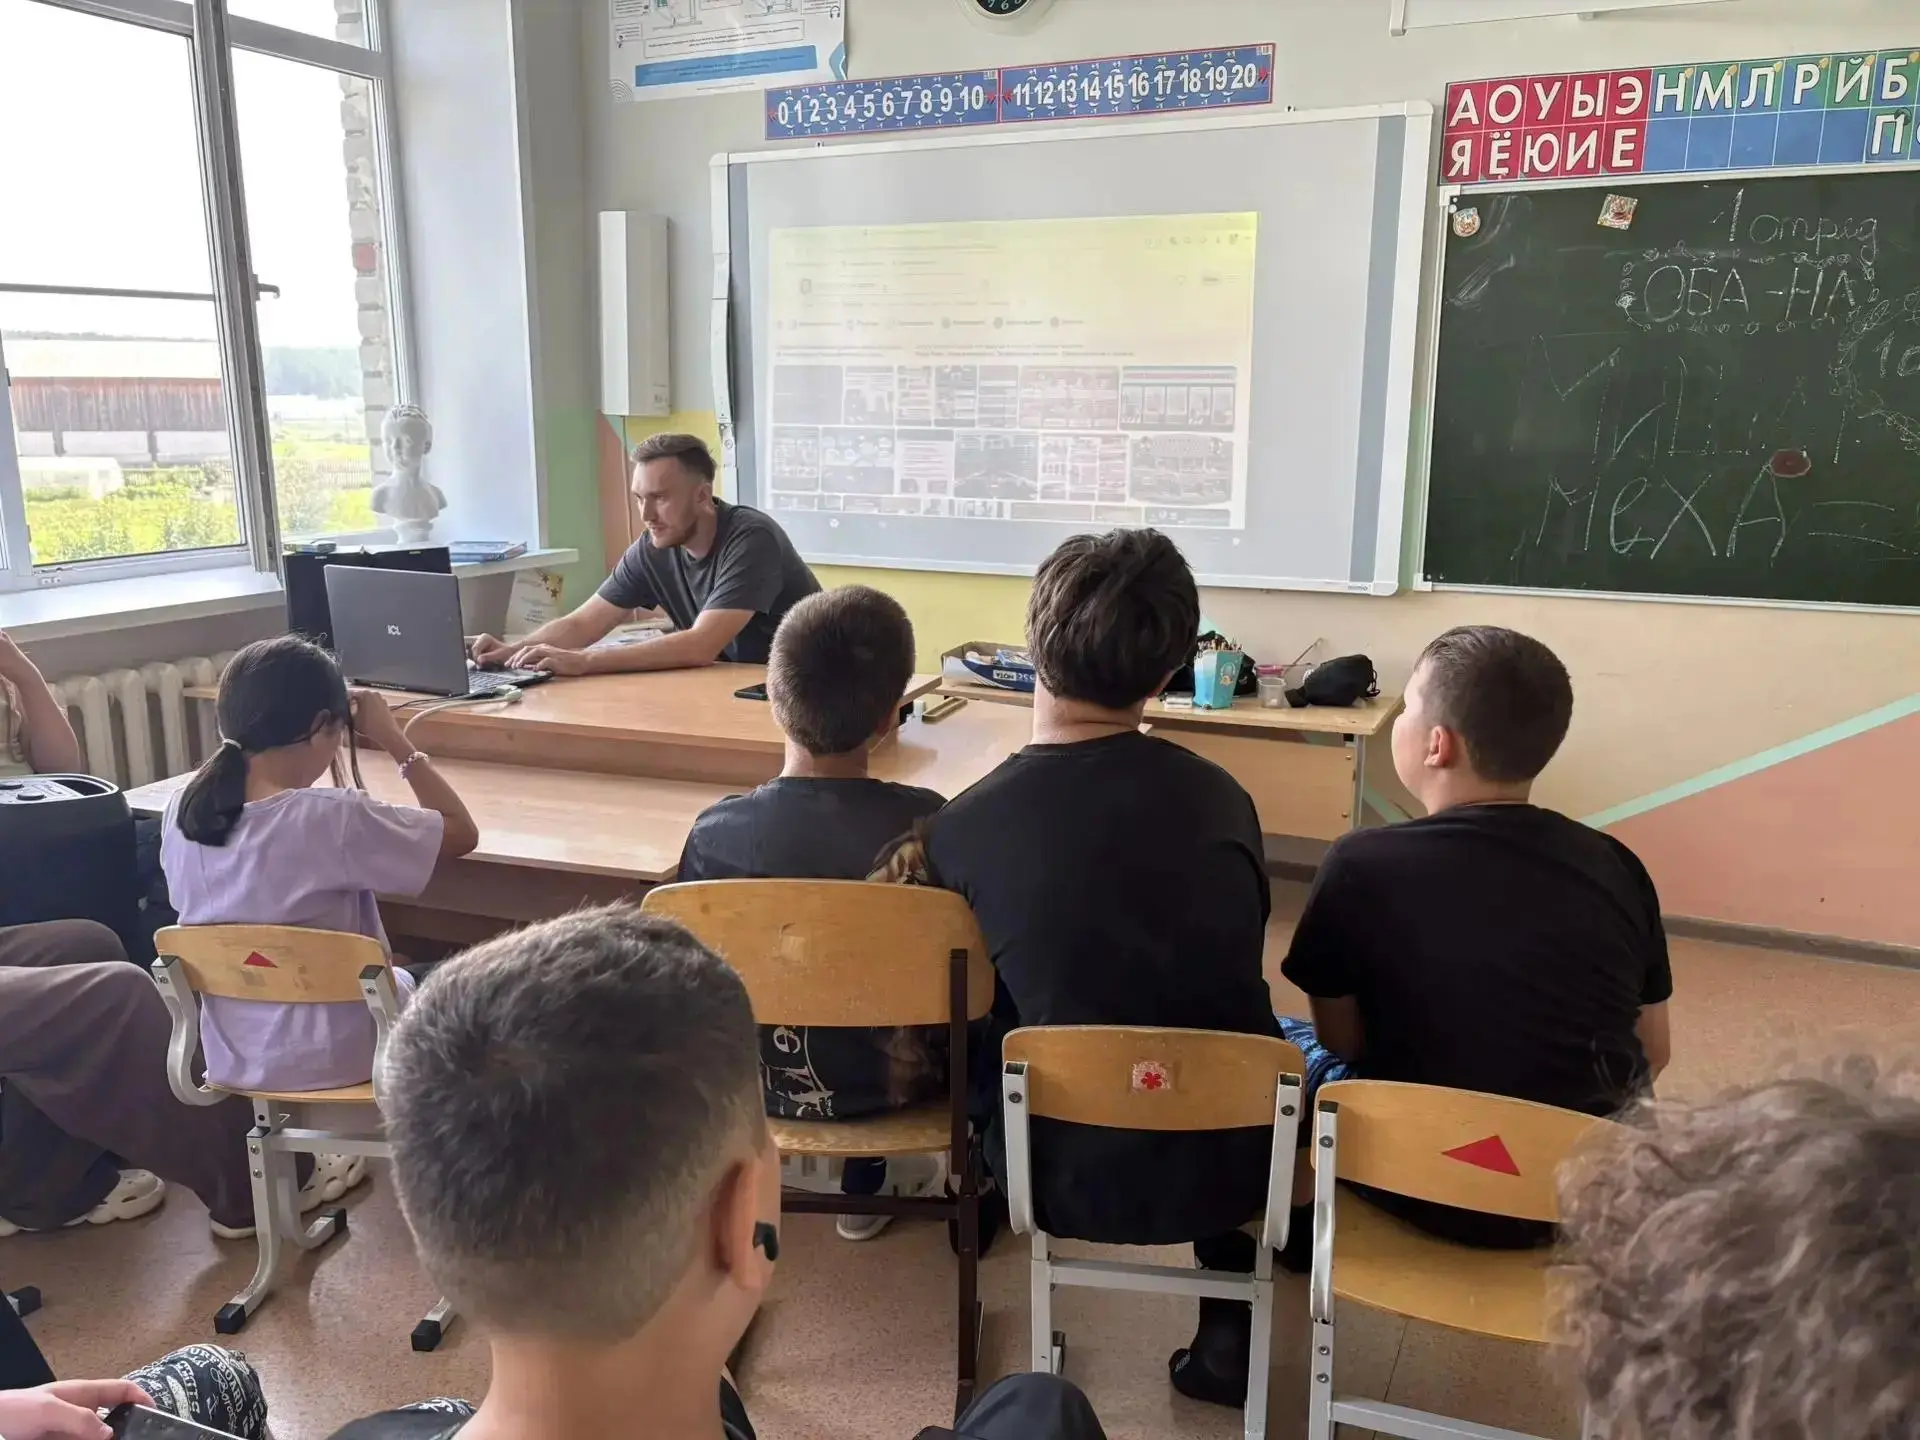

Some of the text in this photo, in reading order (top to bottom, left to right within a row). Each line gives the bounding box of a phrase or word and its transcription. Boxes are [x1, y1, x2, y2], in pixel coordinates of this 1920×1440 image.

[778, 85, 984, 124] 0 1 2 3 4 5 6 7 8 9 10
[1013, 63, 1256, 106] 11 12 13 14 15 16 17 18 19 20
[1449, 57, 1907, 127] А О У Ы Э Н М Л Р Й Б
[1448, 114, 1906, 176] Я Ё Ю И Е П
[387, 624, 401, 636] ICL
